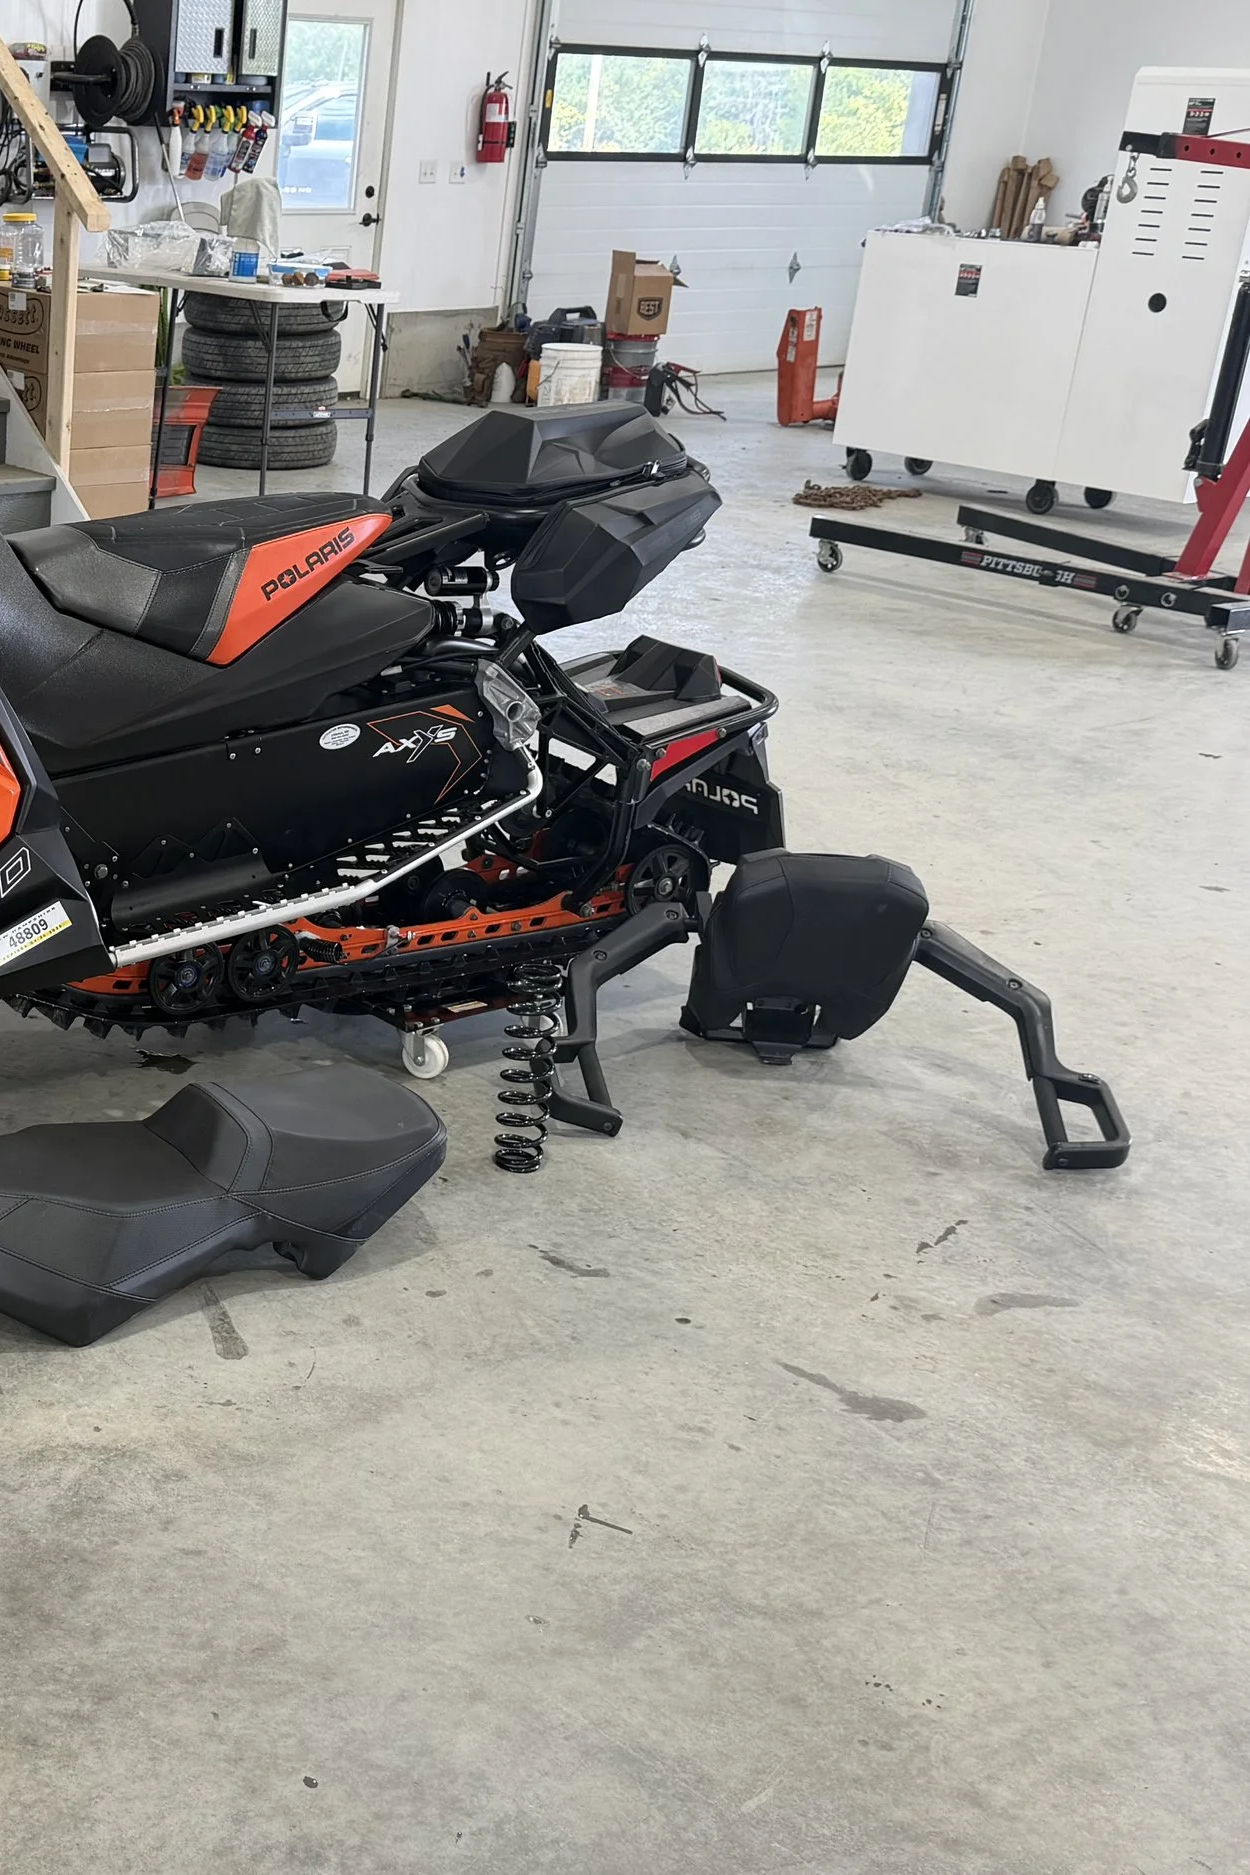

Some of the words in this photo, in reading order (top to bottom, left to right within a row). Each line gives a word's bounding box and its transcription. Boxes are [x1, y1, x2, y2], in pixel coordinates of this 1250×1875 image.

[13, 339, 41, 355] WHEEL
[260, 526, 356, 602] POLARIS
[980, 555, 1076, 584] PITTSBUGH
[8, 918, 49, 948] 48809
